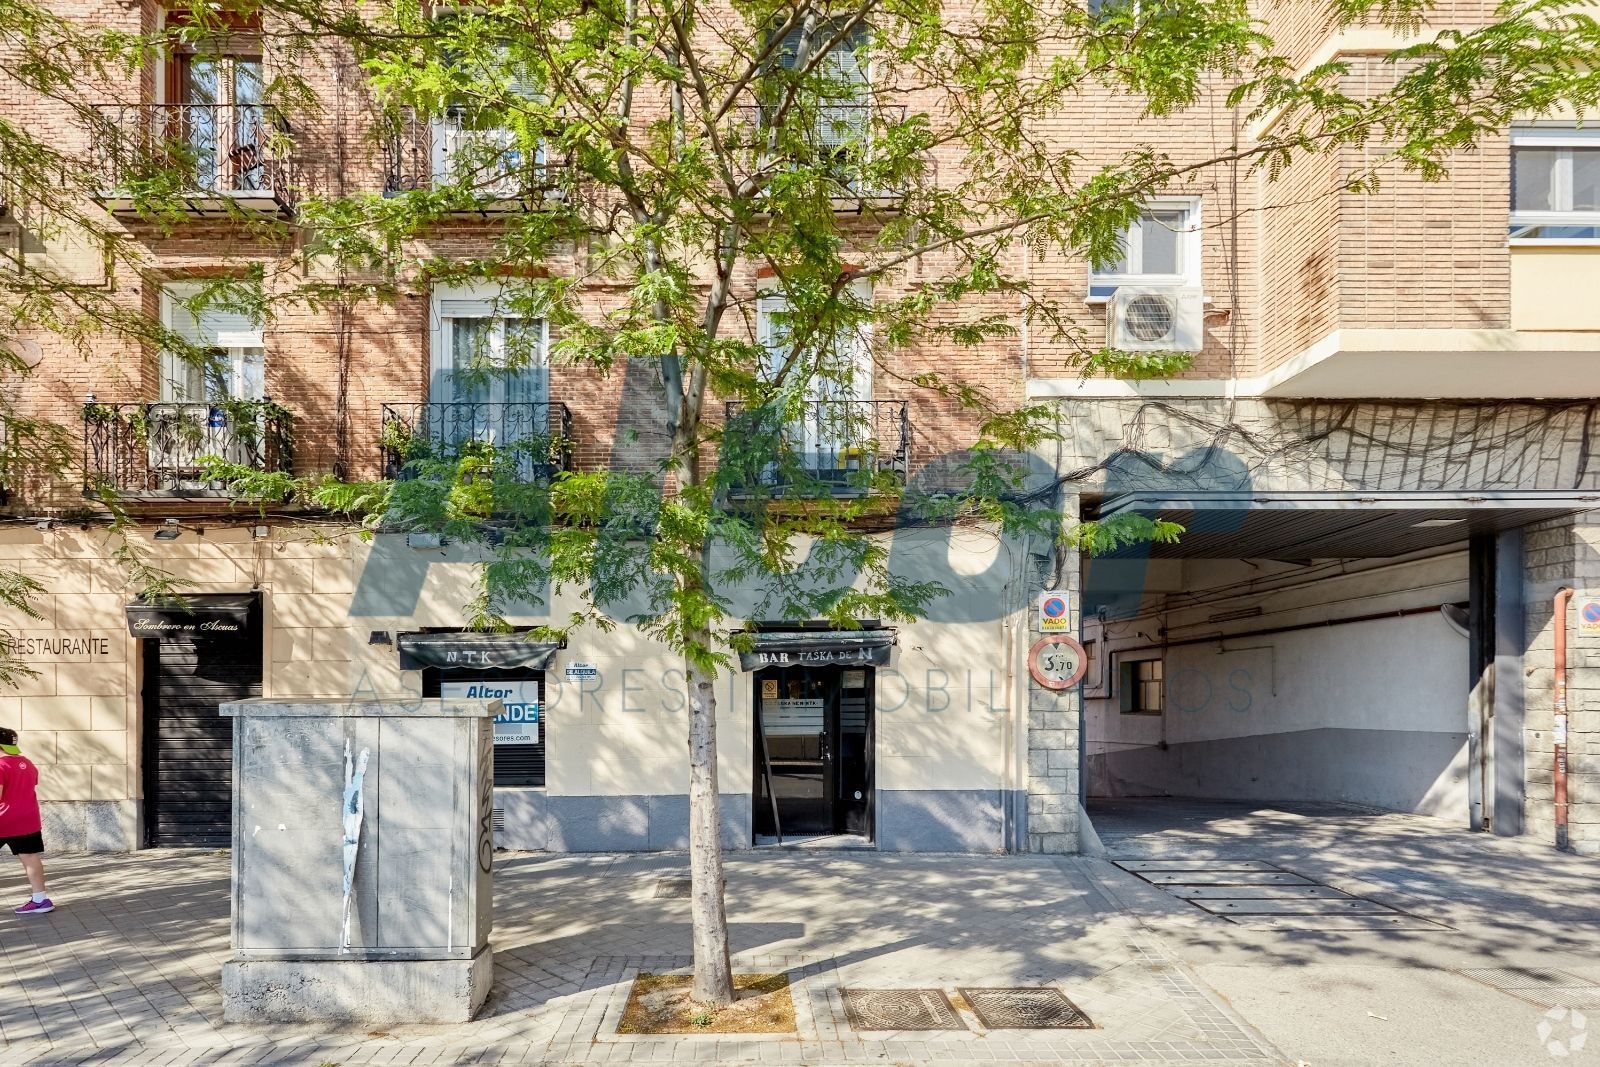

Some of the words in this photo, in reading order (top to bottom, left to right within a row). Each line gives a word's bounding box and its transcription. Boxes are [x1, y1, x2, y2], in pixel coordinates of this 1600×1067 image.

[133, 618, 182, 630] Sombrero
[199, 619, 239, 631] Ascuas
[7, 638, 109, 655] RESTAURANTE
[758, 652, 789, 663] BAR
[797, 651, 834, 661] TASKA
[838, 651, 852, 659] DE
[858, 647, 874, 660] N
[466, 685, 513, 699] Altor
[493, 704, 536, 721] NDE
